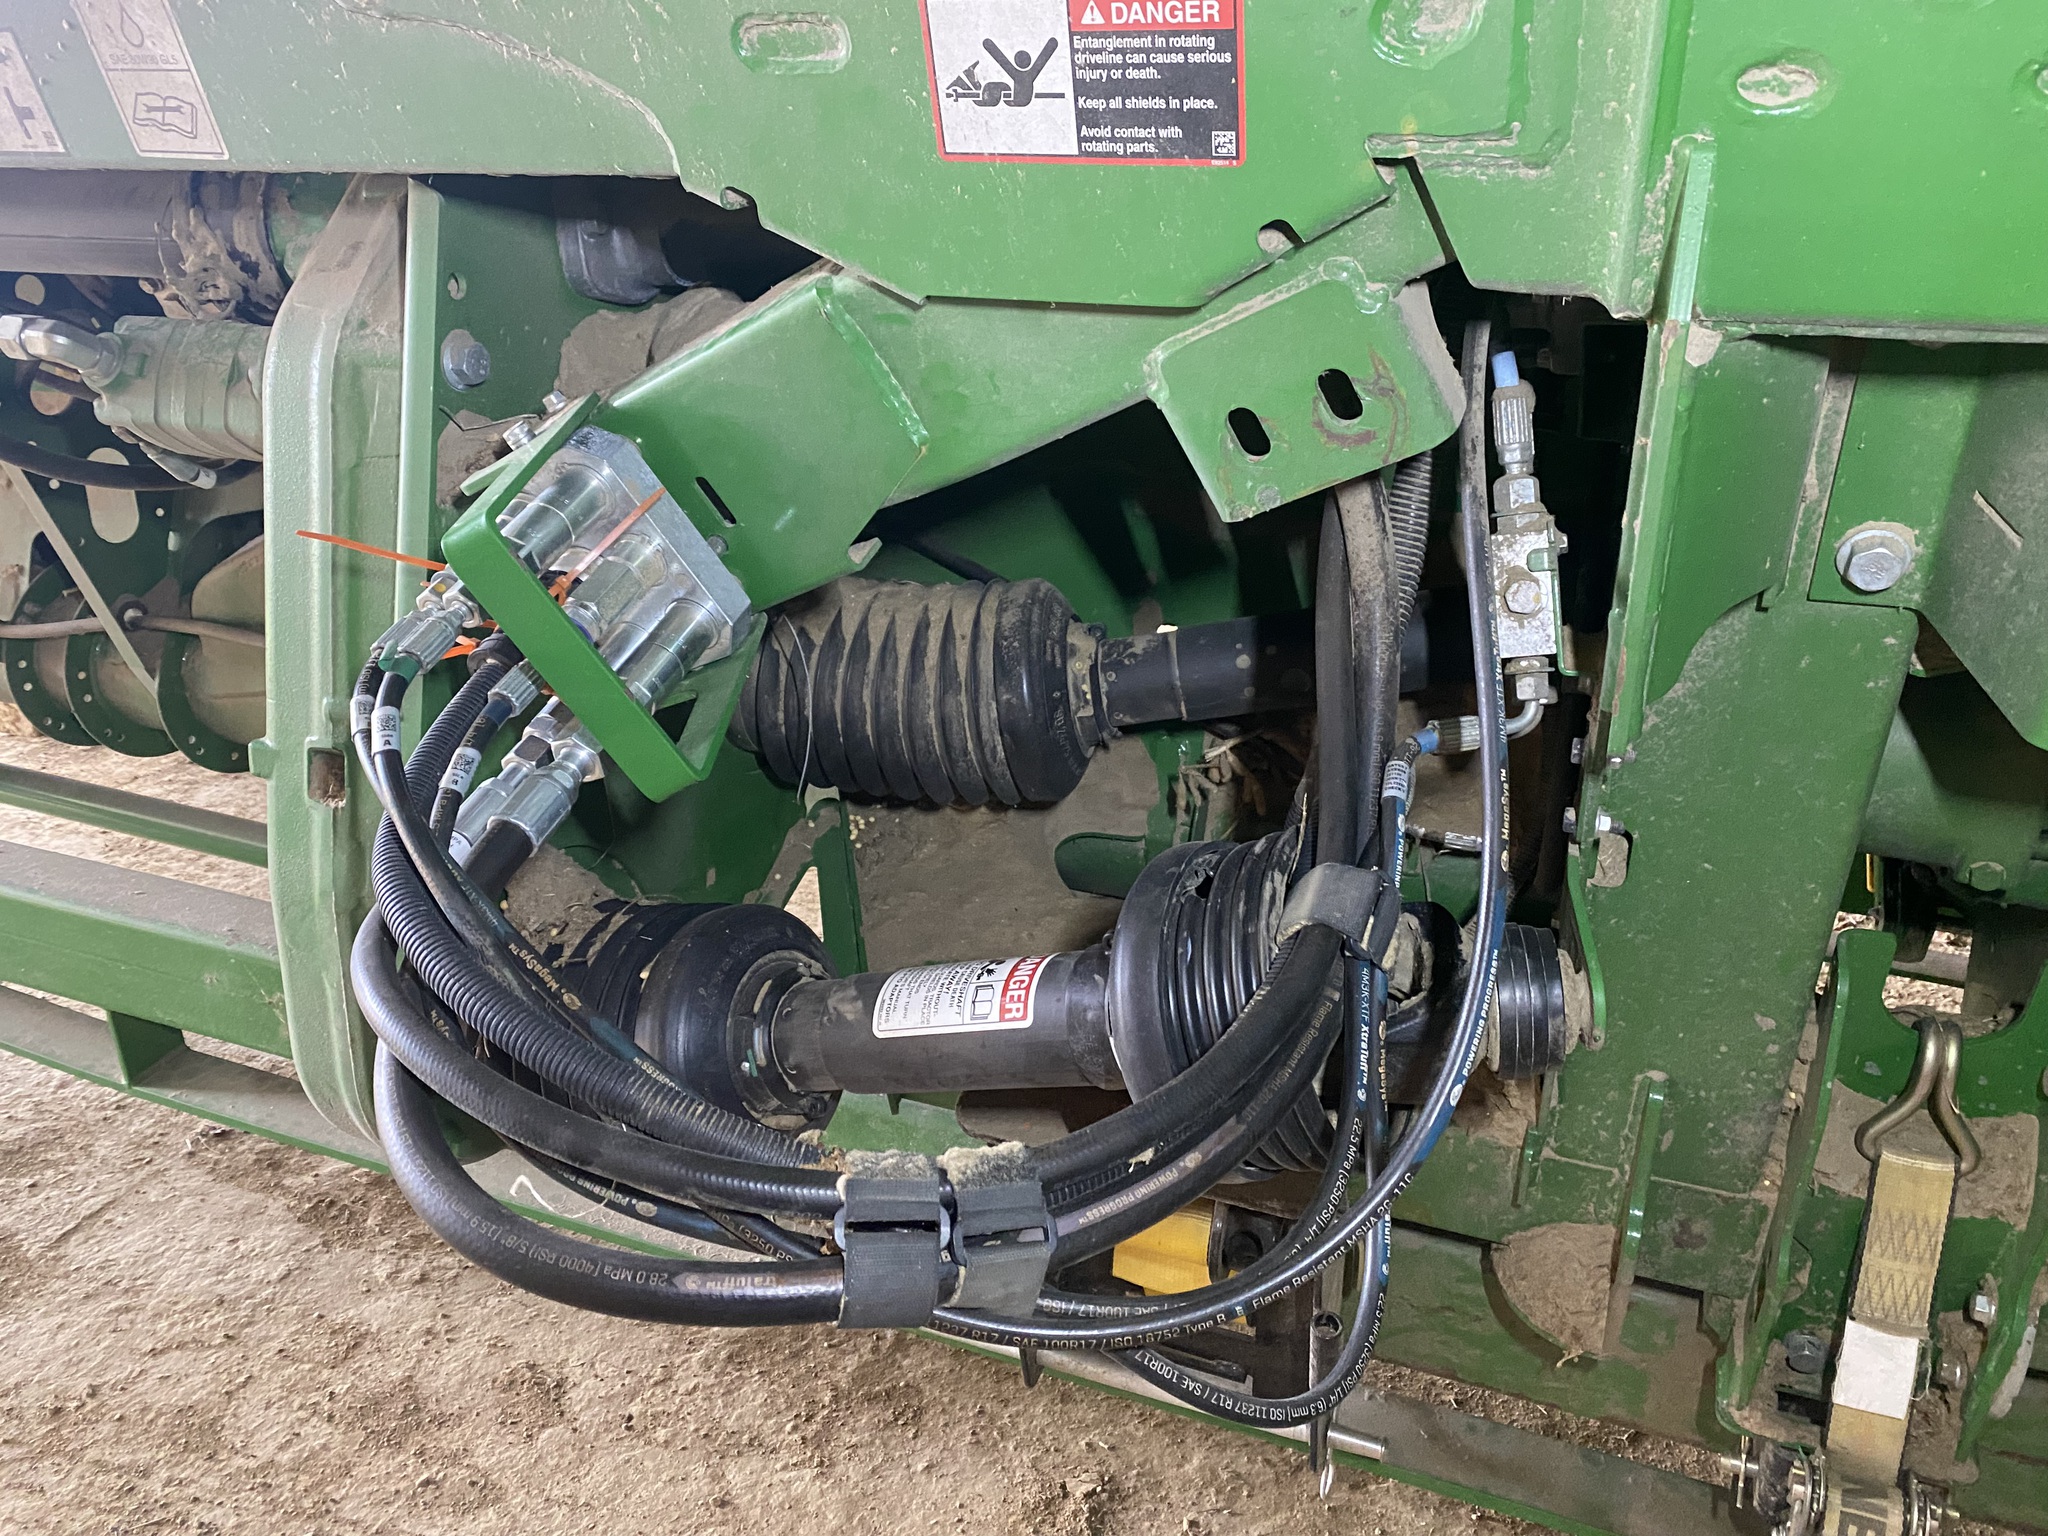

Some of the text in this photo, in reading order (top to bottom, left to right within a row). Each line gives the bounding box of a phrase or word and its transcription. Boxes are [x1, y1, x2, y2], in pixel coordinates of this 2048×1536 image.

[1111, 1, 1220, 24] DANGER
[1073, 34, 1215, 51] Entanglement in rotating
[1074, 50, 1232, 64] driveline can cause serious
[1075, 66, 1161, 82] injury or death.
[1078, 96, 1218, 112] Keep all shields in place.
[1081, 125, 1182, 138] Avoid contact with
[1081, 140, 1158, 155] rotating parts.
[383, 739, 392, 747] A
[1004, 955, 1042, 1020] ANGER
[1312, 1000, 1333, 1028] Flame
[1463, 1026, 1482, 1077] POWERING
[1348, 1117, 1364, 1146] 22.5
[1343, 1144, 1358, 1169] MPa
[558, 1254, 601, 1278] (4000
[1252, 1285, 1291, 1310] Flame
[1292, 1245, 1346, 1288] Resistant
[1346, 1218, 1378, 1247] MSHA
[603, 1265, 632, 1284] MPa
[636, 1270, 668, 1287] 28.0
[1110, 1337, 1133, 1349] ISO
[1134, 1350, 1180, 1383] 100R17
[1181, 1376, 1203, 1397] SAE
[1204, 1386, 1210, 1397] /
[1211, 1392, 1233, 1410] R17
[1235, 1402, 1267, 1420] 11237
[1270, 1406, 1286, 1420] ISO
